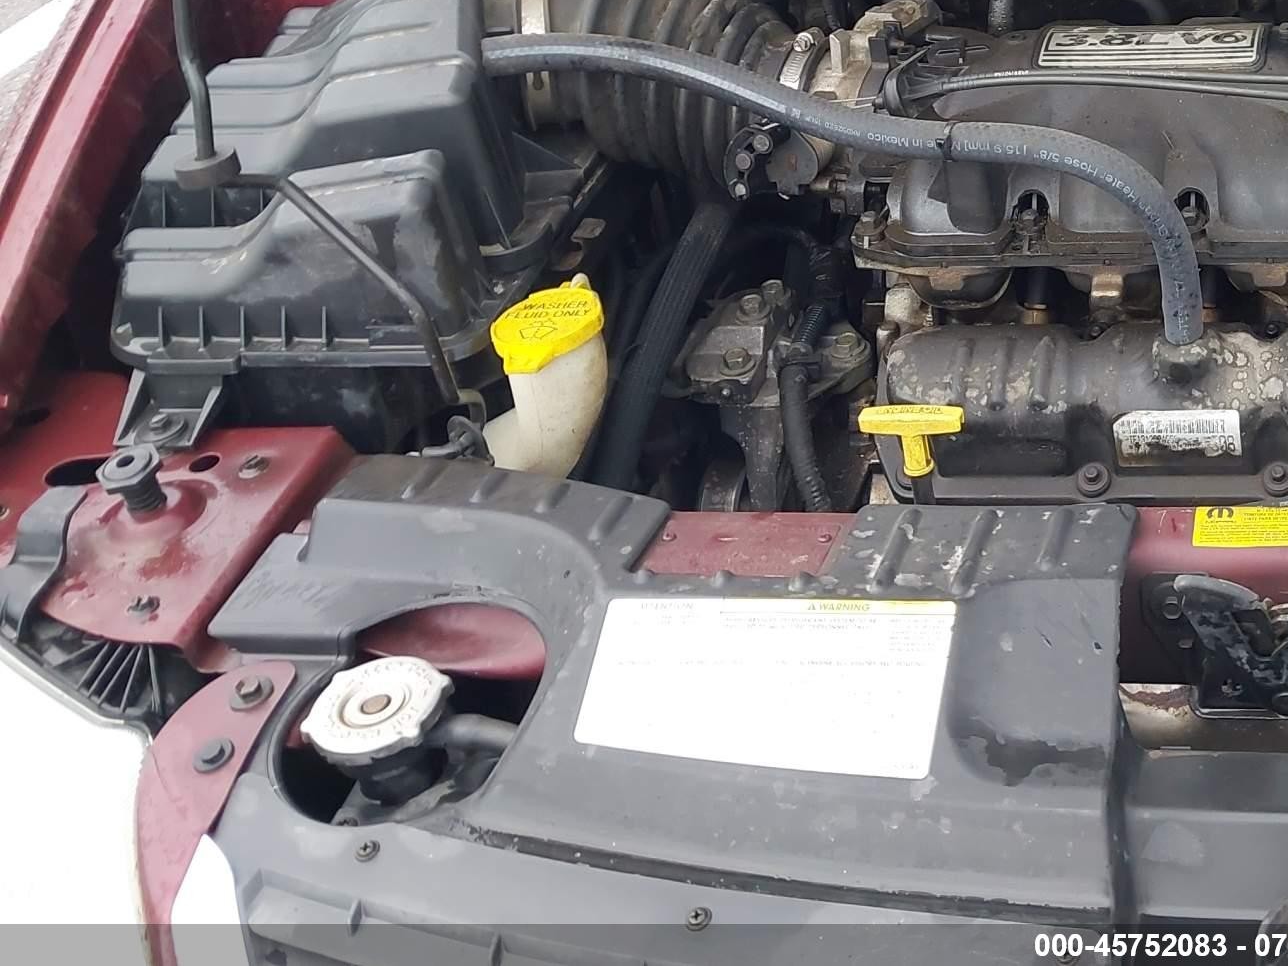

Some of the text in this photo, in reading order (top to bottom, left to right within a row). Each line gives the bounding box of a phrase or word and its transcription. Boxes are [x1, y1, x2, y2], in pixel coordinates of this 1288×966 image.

[1055, 31, 1248, 48] 3.8L V6
[867, 132, 909, 148] Mexico
[1064, 155, 1098, 178] Hose
[522, 299, 589, 311] WASHER
[504, 307, 592, 320] FLUID ONLY
[819, 603, 871, 612] WARNING
